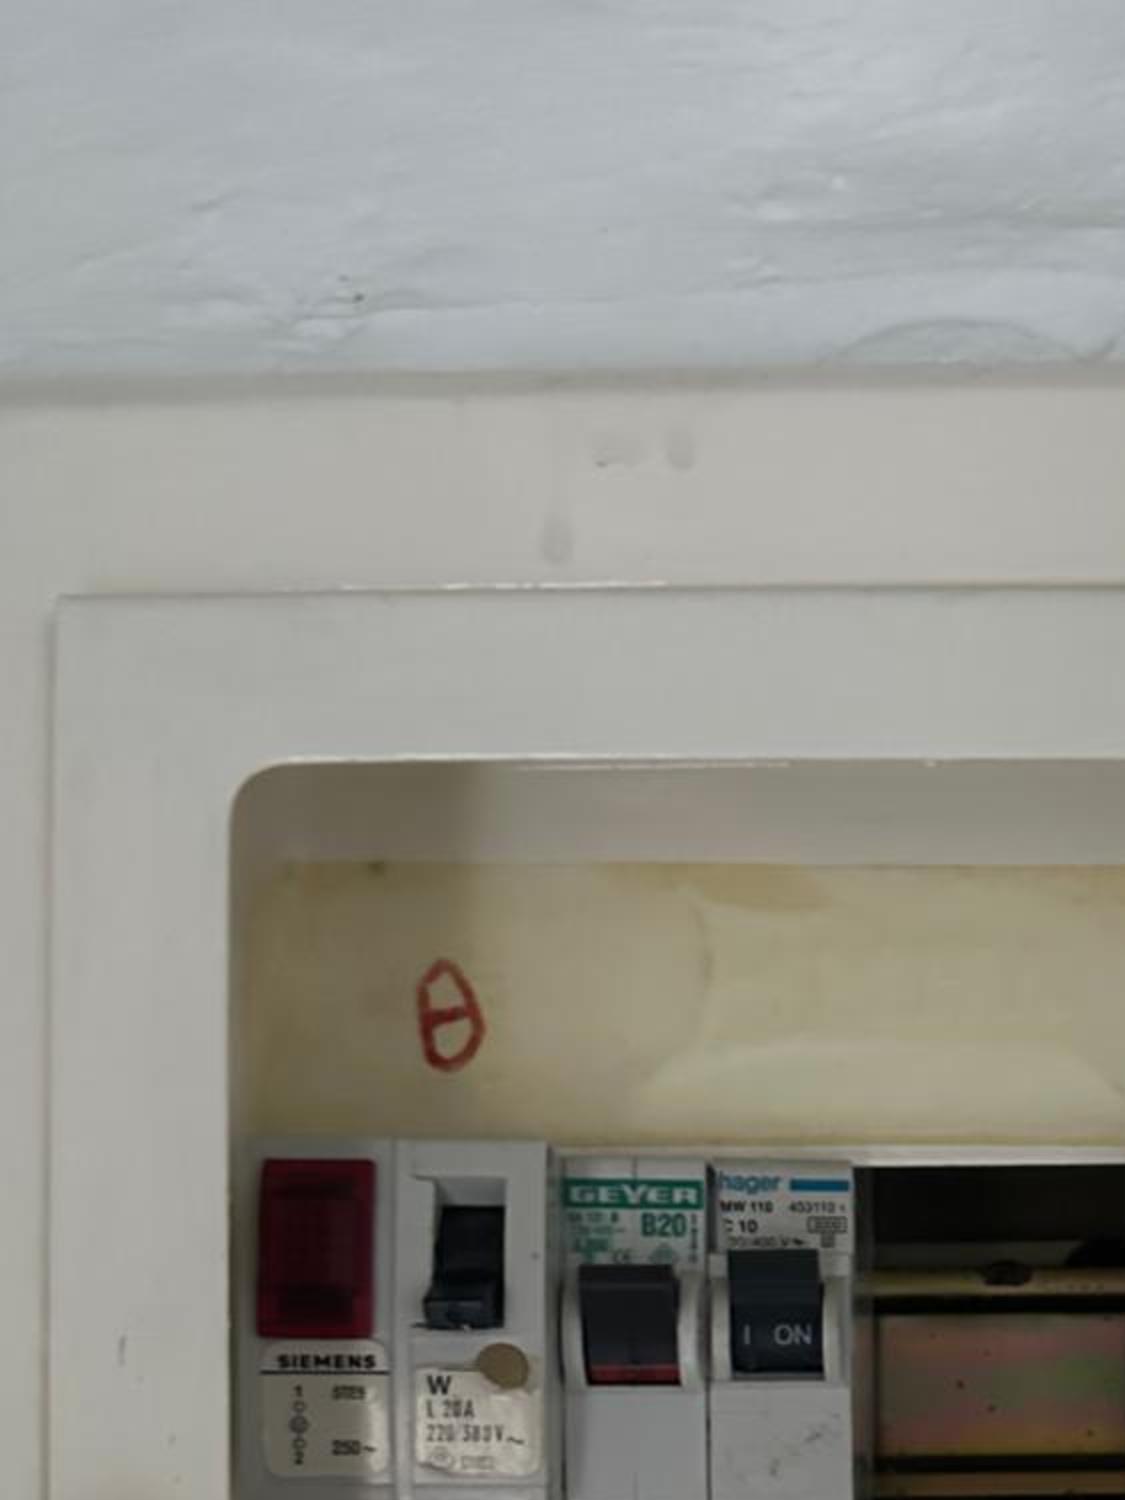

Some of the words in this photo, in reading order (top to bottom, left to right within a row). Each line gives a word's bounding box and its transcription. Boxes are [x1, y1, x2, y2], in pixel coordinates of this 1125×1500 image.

[569, 1184, 698, 1204] GEYER
[641, 1212, 686, 1238] B20
[739, 1219, 759, 1233] 10
[774, 1325, 813, 1346] ON
[278, 1354, 376, 1369] SIEMENS
[427, 1375, 451, 1395] W
